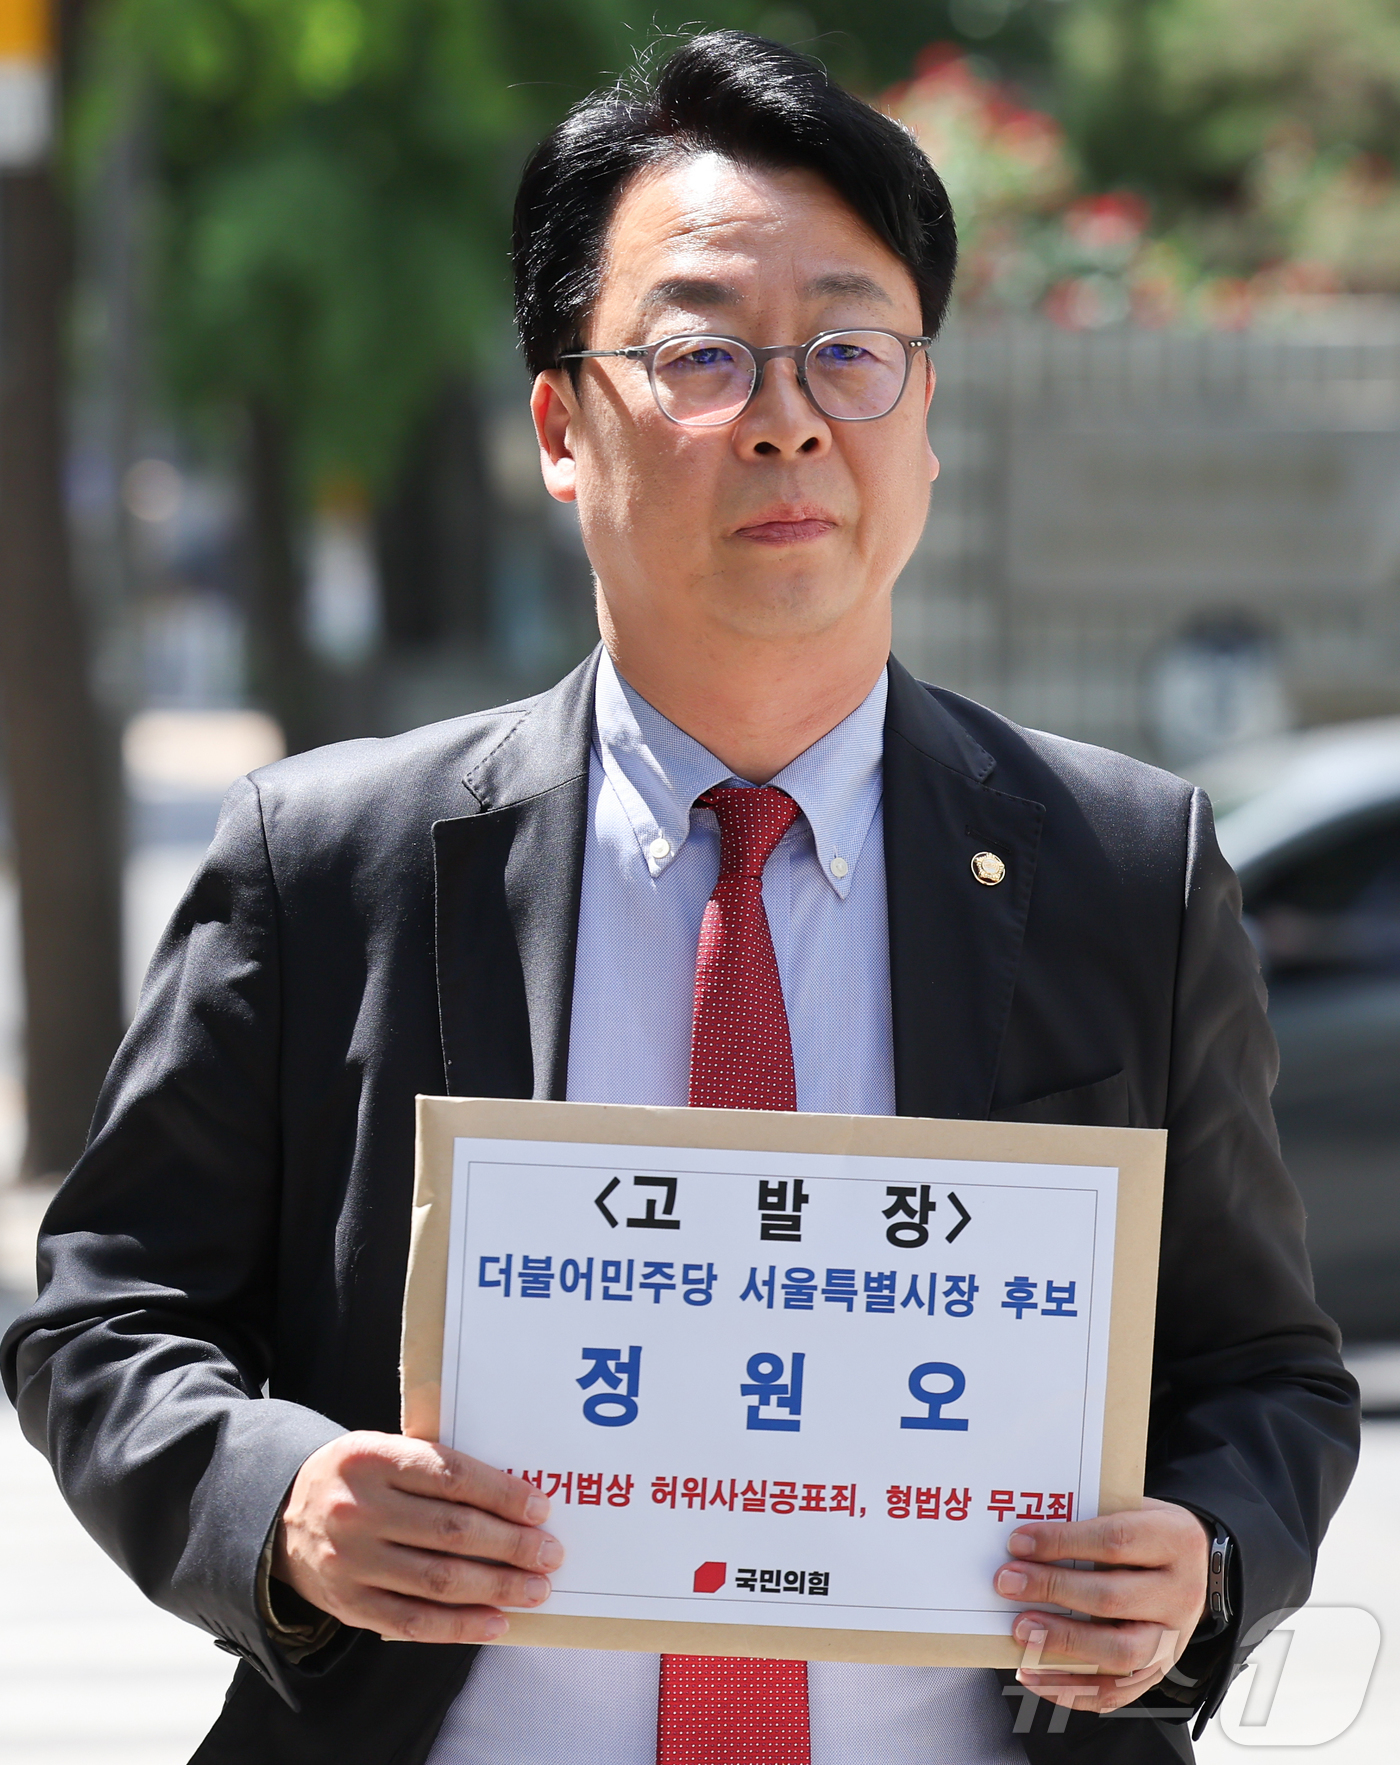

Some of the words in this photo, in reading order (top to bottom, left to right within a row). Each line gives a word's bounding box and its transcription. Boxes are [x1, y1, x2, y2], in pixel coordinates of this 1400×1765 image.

[757, 1178, 809, 1242] 발
[478, 1253, 718, 1307] 더불어민주당
[739, 1265, 980, 1318] 서울특별시장
[1001, 1276, 1078, 1320] 후보
[575, 1345, 643, 1428] 정
[740, 1352, 806, 1433] 원
[900, 1361, 969, 1432] 오
[651, 1476, 867, 1518] 허위사실공표죄,
[886, 1485, 972, 1521] 형법상
[987, 1489, 1074, 1522] 무고죄
[735, 1568, 830, 1596] 국민의힘
